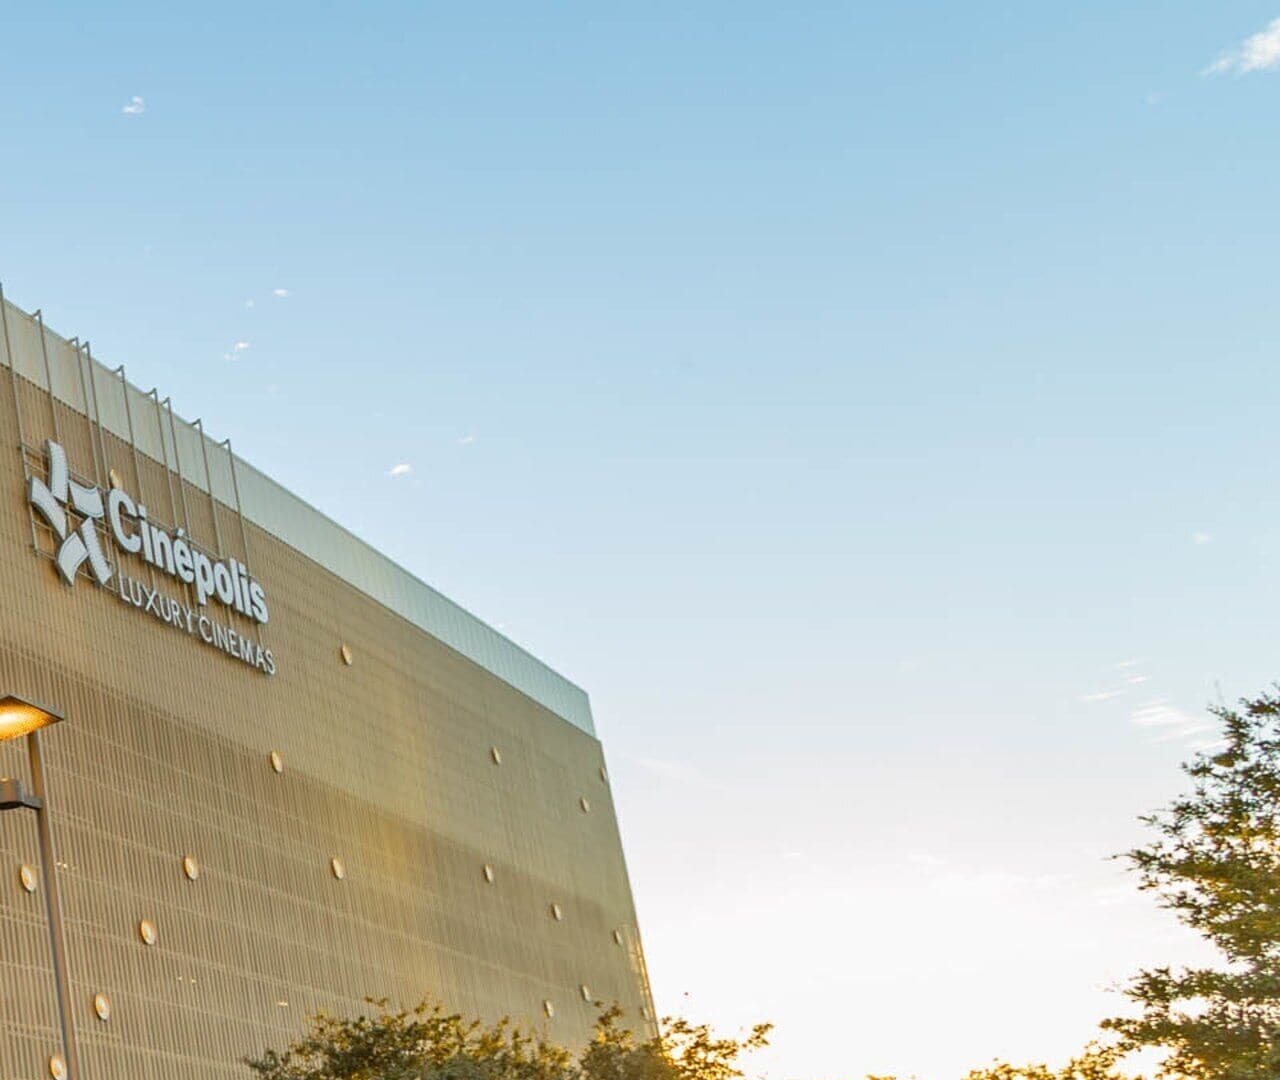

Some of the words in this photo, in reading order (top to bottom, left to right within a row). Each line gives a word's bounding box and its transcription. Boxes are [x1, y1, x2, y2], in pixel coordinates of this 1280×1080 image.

[108, 487, 269, 624] Cinépolis
[118, 575, 197, 634] LUXURY
[198, 616, 276, 675] CINEMAS
